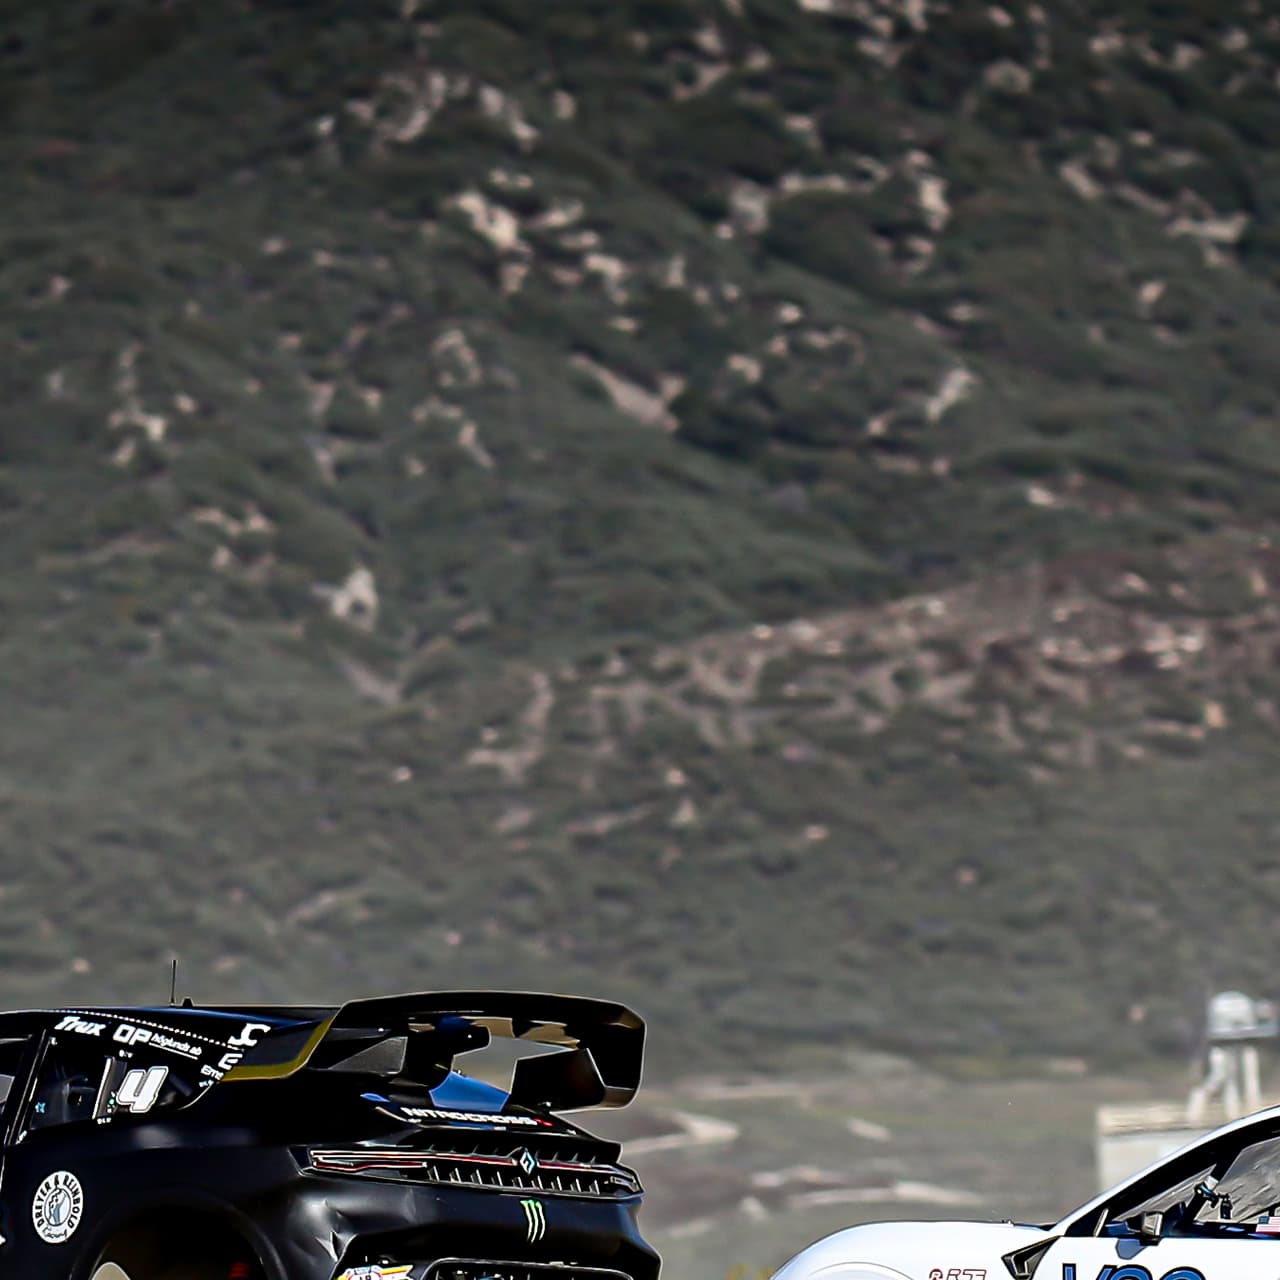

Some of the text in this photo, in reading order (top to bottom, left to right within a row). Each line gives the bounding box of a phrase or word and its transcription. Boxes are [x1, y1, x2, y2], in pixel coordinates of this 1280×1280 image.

[54, 1016, 107, 1037] Trux
[116, 1065, 169, 1113] 4
[35, 1181, 52, 1228] DREYER
[63, 1174, 81, 1229] REINBOLD
